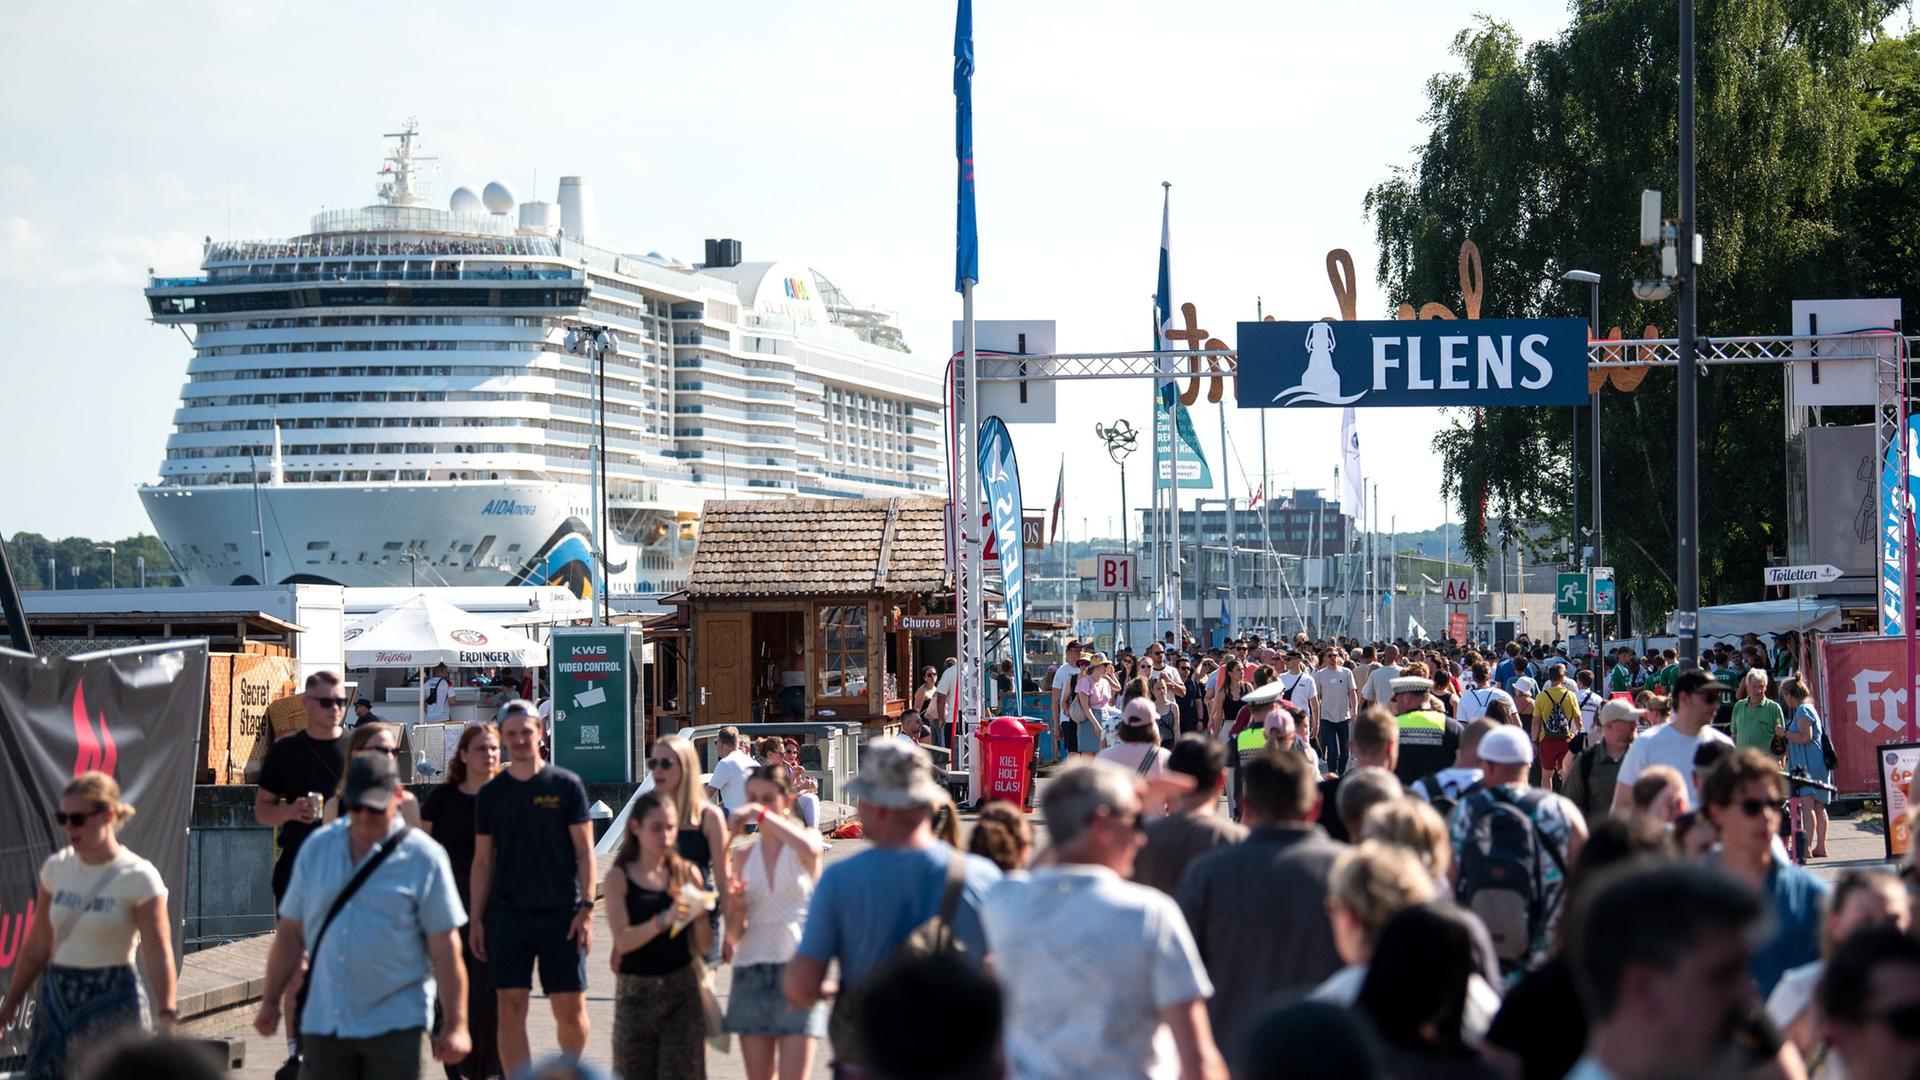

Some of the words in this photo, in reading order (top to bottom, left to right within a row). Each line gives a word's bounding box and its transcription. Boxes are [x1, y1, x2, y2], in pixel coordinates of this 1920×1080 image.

[1372, 333, 1553, 390] FLENS
[1104, 559, 1128, 587] B1
[1769, 568, 1817, 583] Toiletten
[1446, 581, 1467, 600] A6
[902, 616, 941, 628] Churros
[459, 650, 511, 664] ERDINGER
[571, 645, 607, 655] KWS
[558, 662, 583, 672] VIDEO
[583, 661, 621, 672] CONTROL
[240, 677, 270, 706] Secret
[240, 708, 267, 743] Stage
[999, 755, 1018, 767] KIEL
[998, 768, 1018, 779] HOLT
[994, 780, 1020, 792] GLAS!
